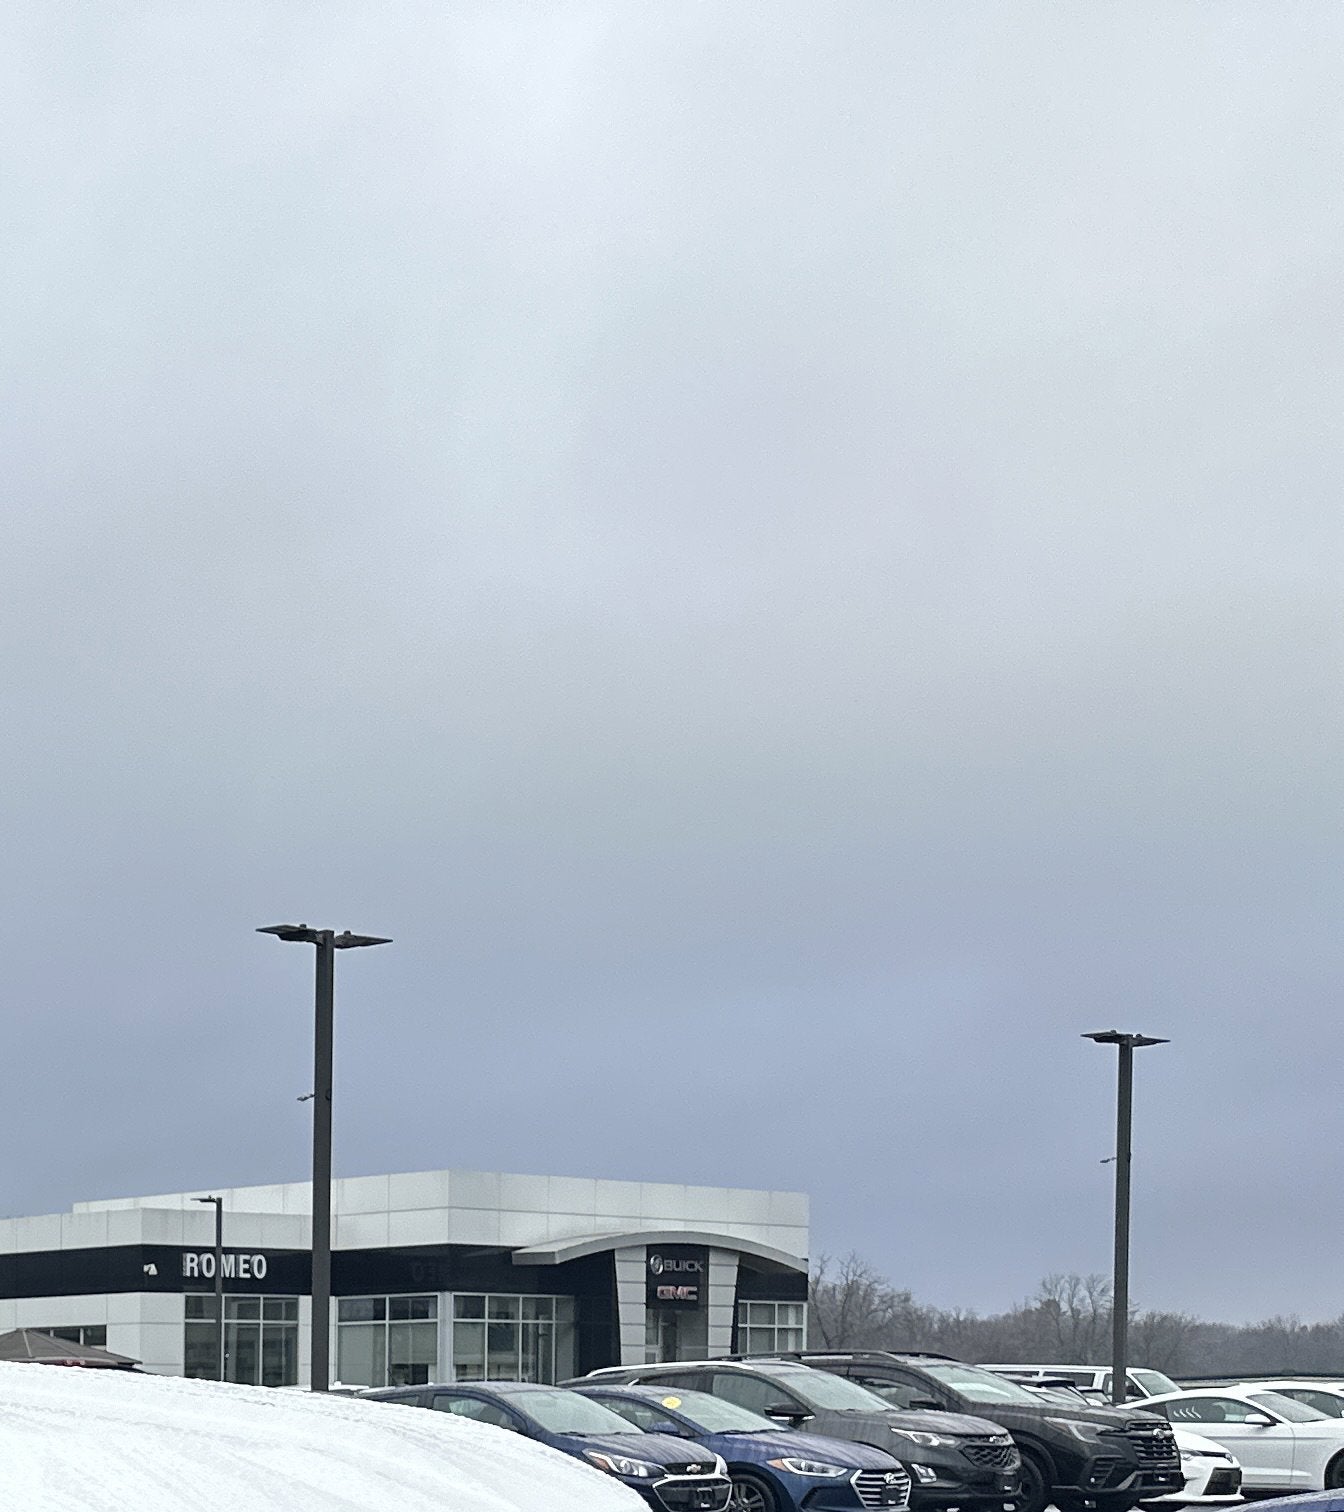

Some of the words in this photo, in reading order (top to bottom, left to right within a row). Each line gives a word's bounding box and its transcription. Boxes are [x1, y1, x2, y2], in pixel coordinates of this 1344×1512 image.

[182, 1252, 267, 1279] ROMEO
[664, 1259, 704, 1273] BUICK
[657, 1285, 698, 1301] GMC
